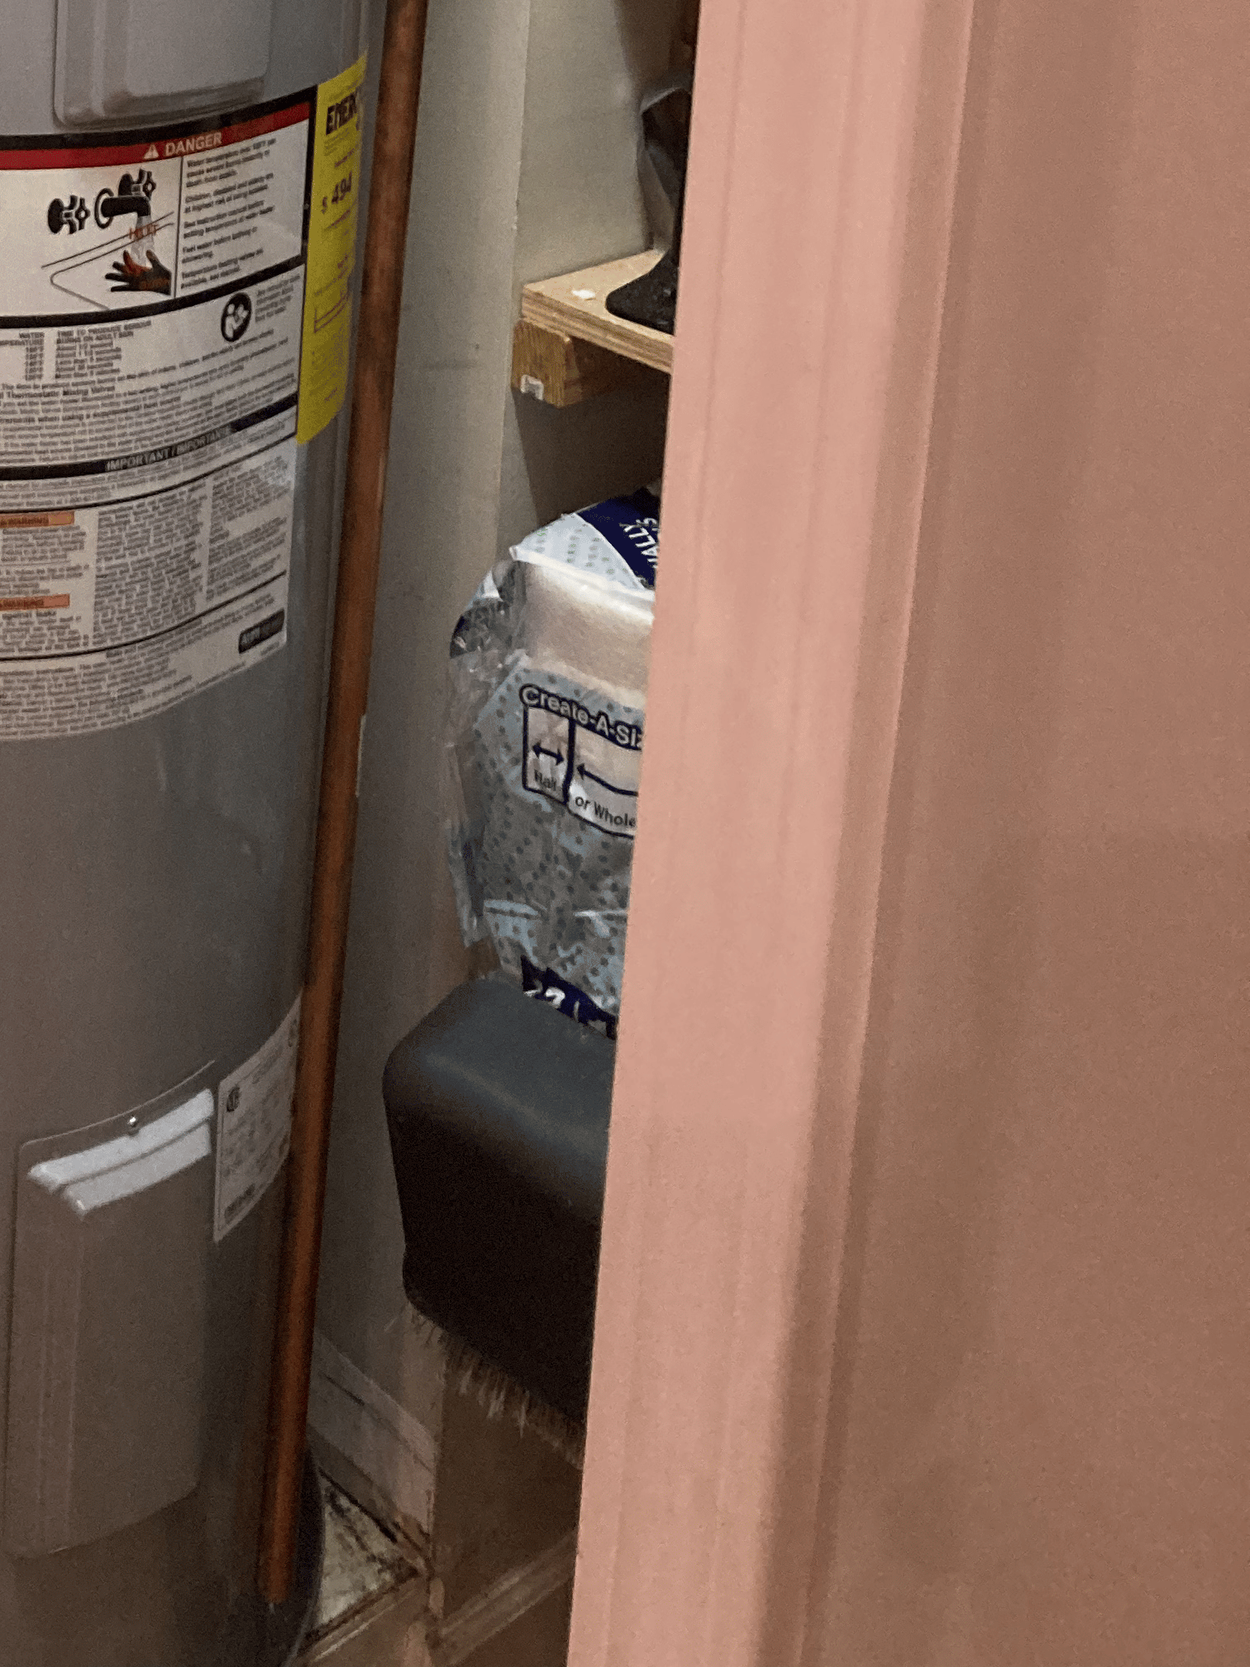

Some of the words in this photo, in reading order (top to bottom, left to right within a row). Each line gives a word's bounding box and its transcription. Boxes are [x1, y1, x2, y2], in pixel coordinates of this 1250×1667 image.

[165, 132, 222, 156] DANGER
[106, 448, 170, 472] IMPORTANT
[521, 685, 641, 747] Create-A-Si
[575, 797, 590, 810] or
